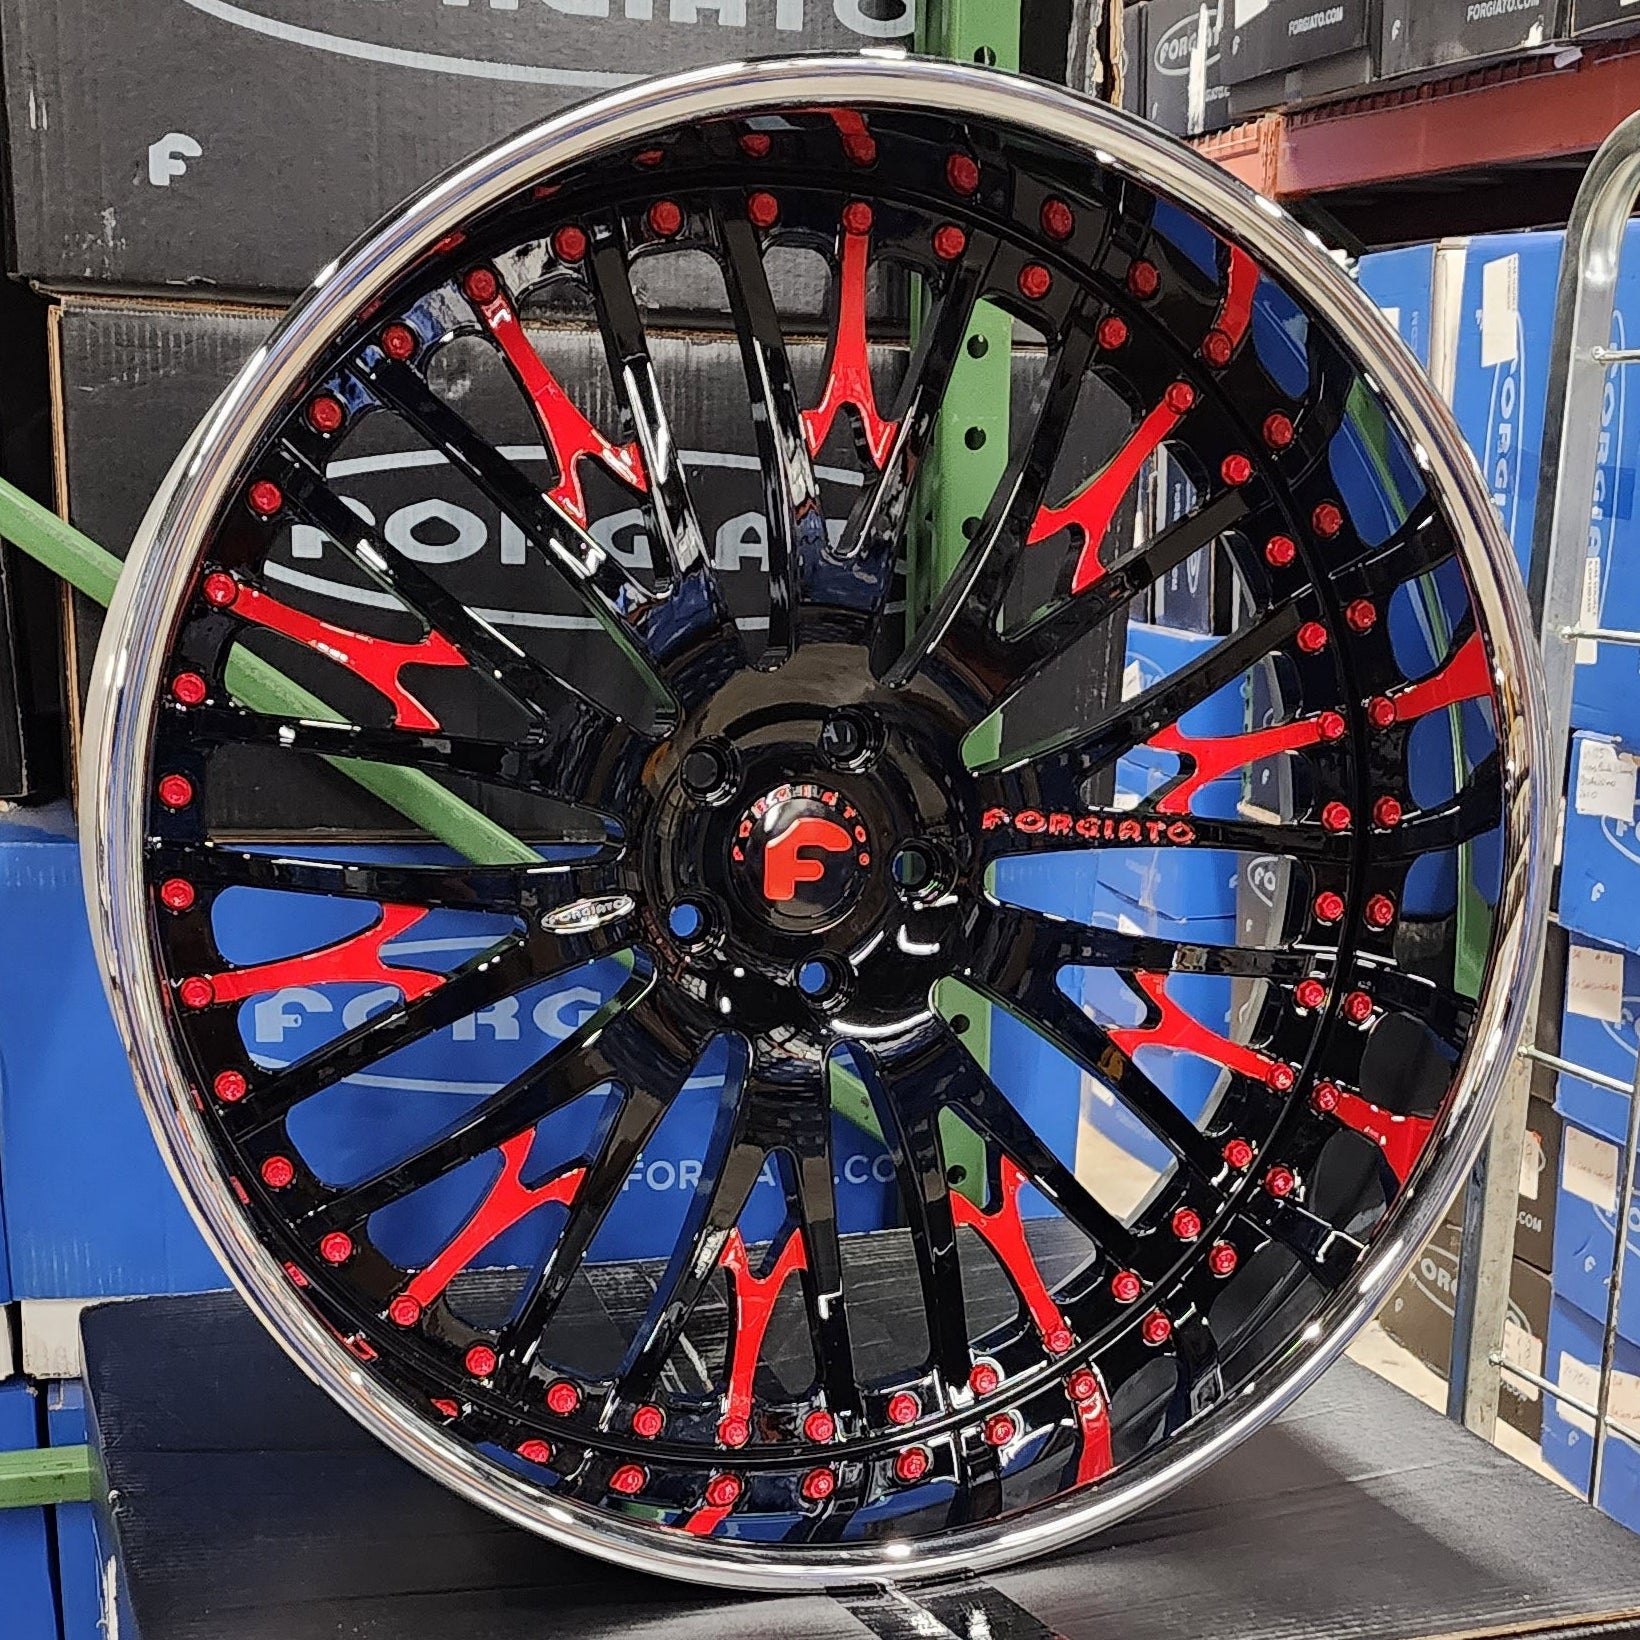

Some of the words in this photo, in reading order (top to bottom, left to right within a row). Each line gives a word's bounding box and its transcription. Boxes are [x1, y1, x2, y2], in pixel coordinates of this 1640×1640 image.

[1288, 6, 1344, 37] FORGIATO.COM
[148, 132, 203, 187] F
[981, 807, 1196, 845] FORGIATO
[764, 817, 853, 900] F
